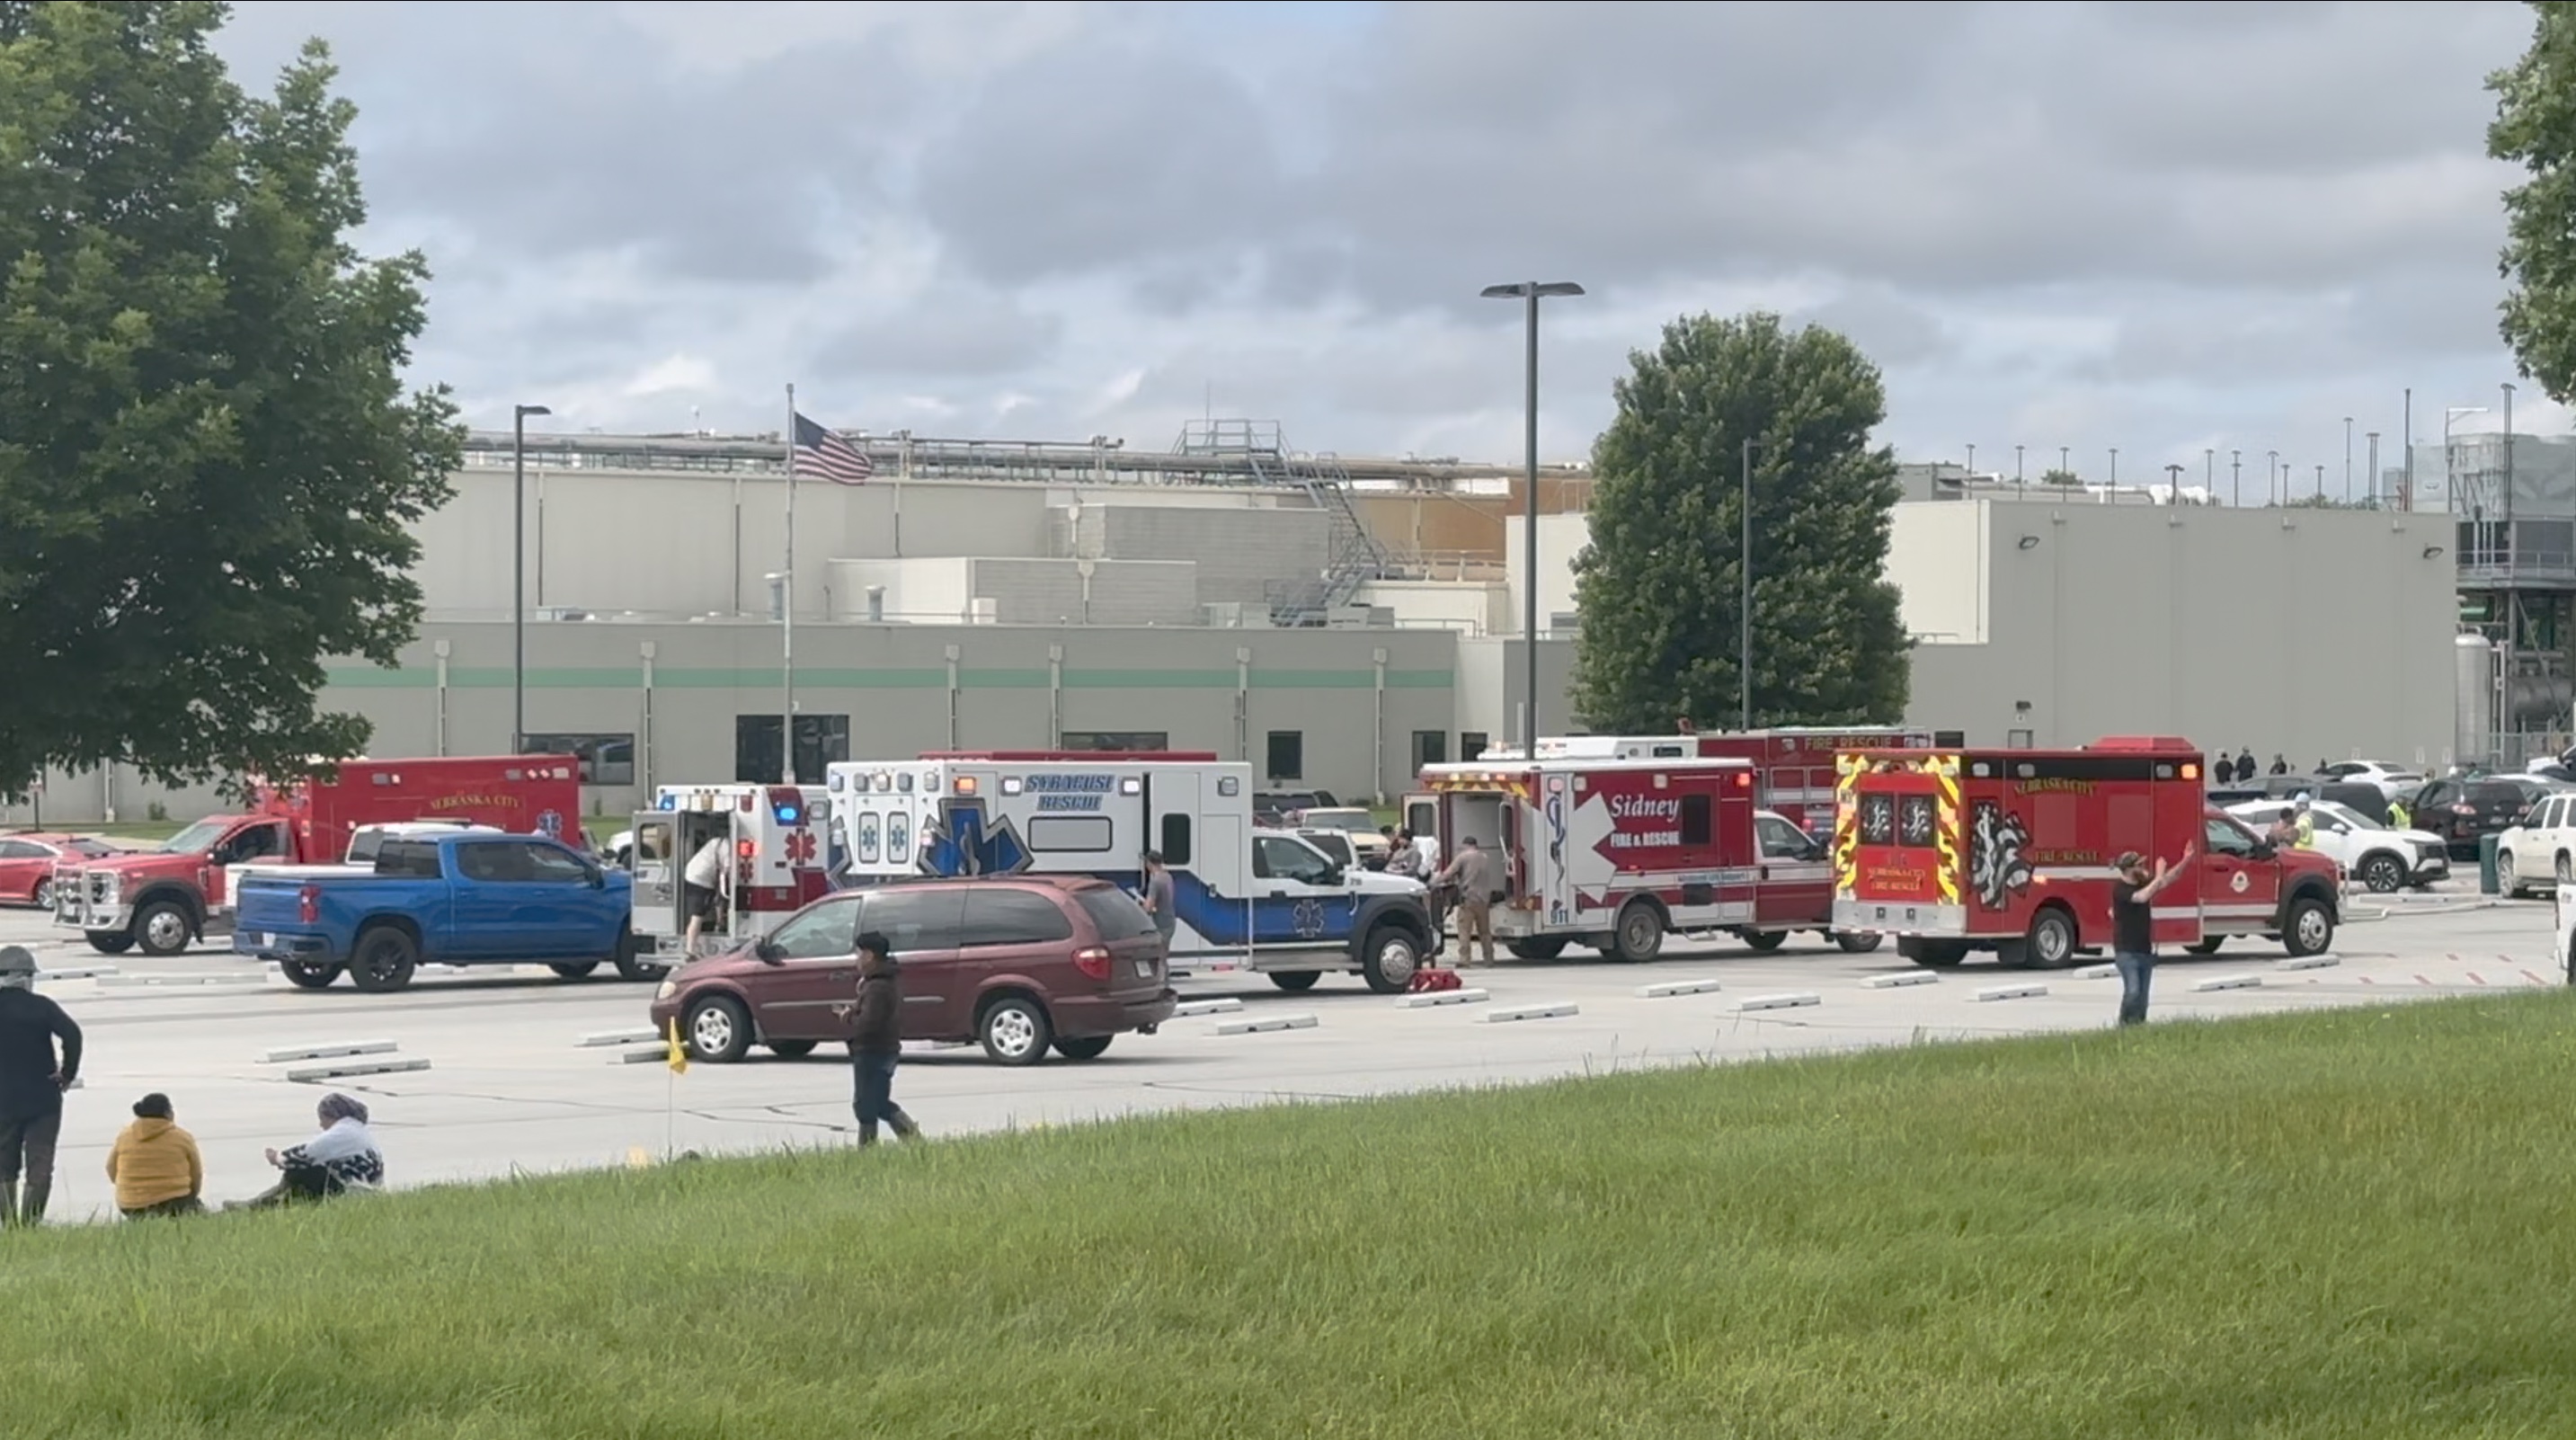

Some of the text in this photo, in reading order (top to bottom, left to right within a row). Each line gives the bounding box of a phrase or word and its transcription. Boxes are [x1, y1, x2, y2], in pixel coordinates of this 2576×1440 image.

[1804, 736, 1891, 751] FIRE RESCUE
[1025, 774, 1115, 793] SYRACUSE
[431, 794, 519, 810] NEBRASKA CITY
[1036, 794, 1103, 812] RESCUE
[1611, 793, 1680, 823] Sidney
[1611, 831, 1680, 848] FIRE & RESCUE
[1550, 908, 1569, 924] 911
